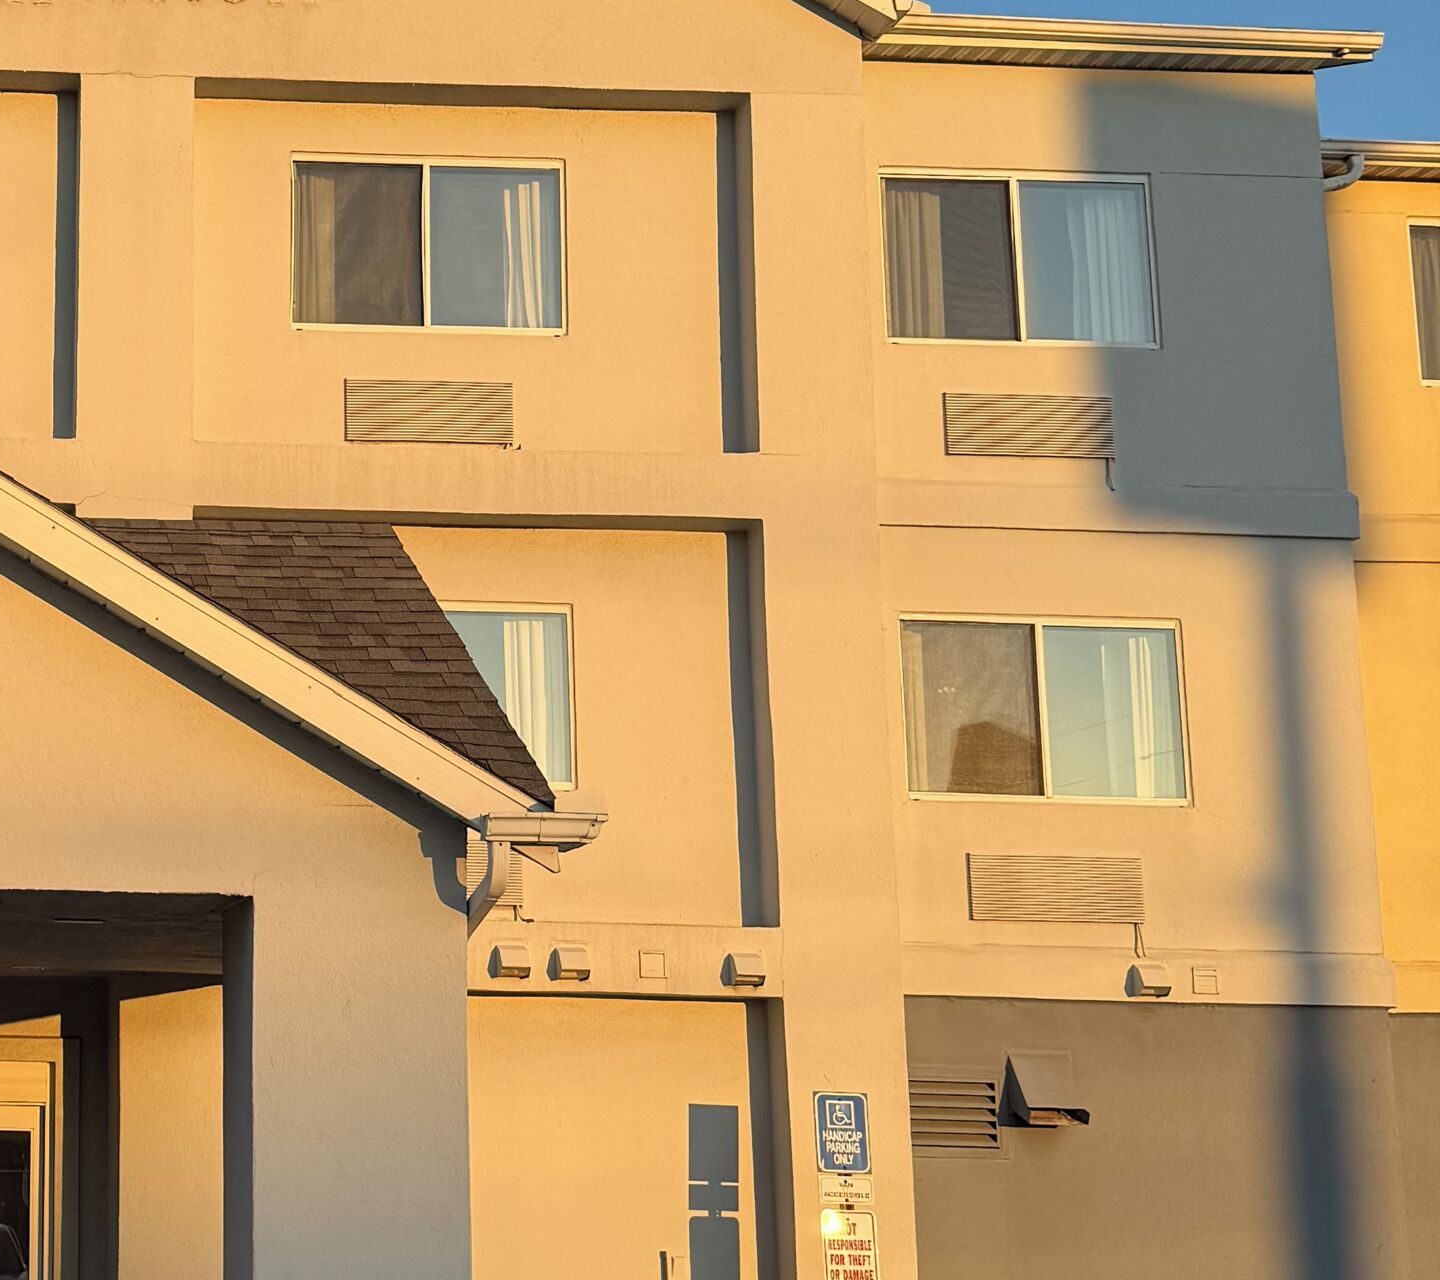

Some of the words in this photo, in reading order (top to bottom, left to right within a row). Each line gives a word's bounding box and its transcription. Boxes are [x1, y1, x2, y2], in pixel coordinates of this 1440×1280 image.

[822, 1129, 863, 1142] HANDICAP
[826, 1141, 861, 1154] PARKING
[833, 1153, 854, 1165] ONLY
[827, 1239, 872, 1251] RESPONSIBLE
[830, 1254, 845, 1266] FOR
[848, 1254, 871, 1266] THEFT
[830, 1269, 840, 1280] OR
[843, 1269, 874, 1280] DAMAGE
